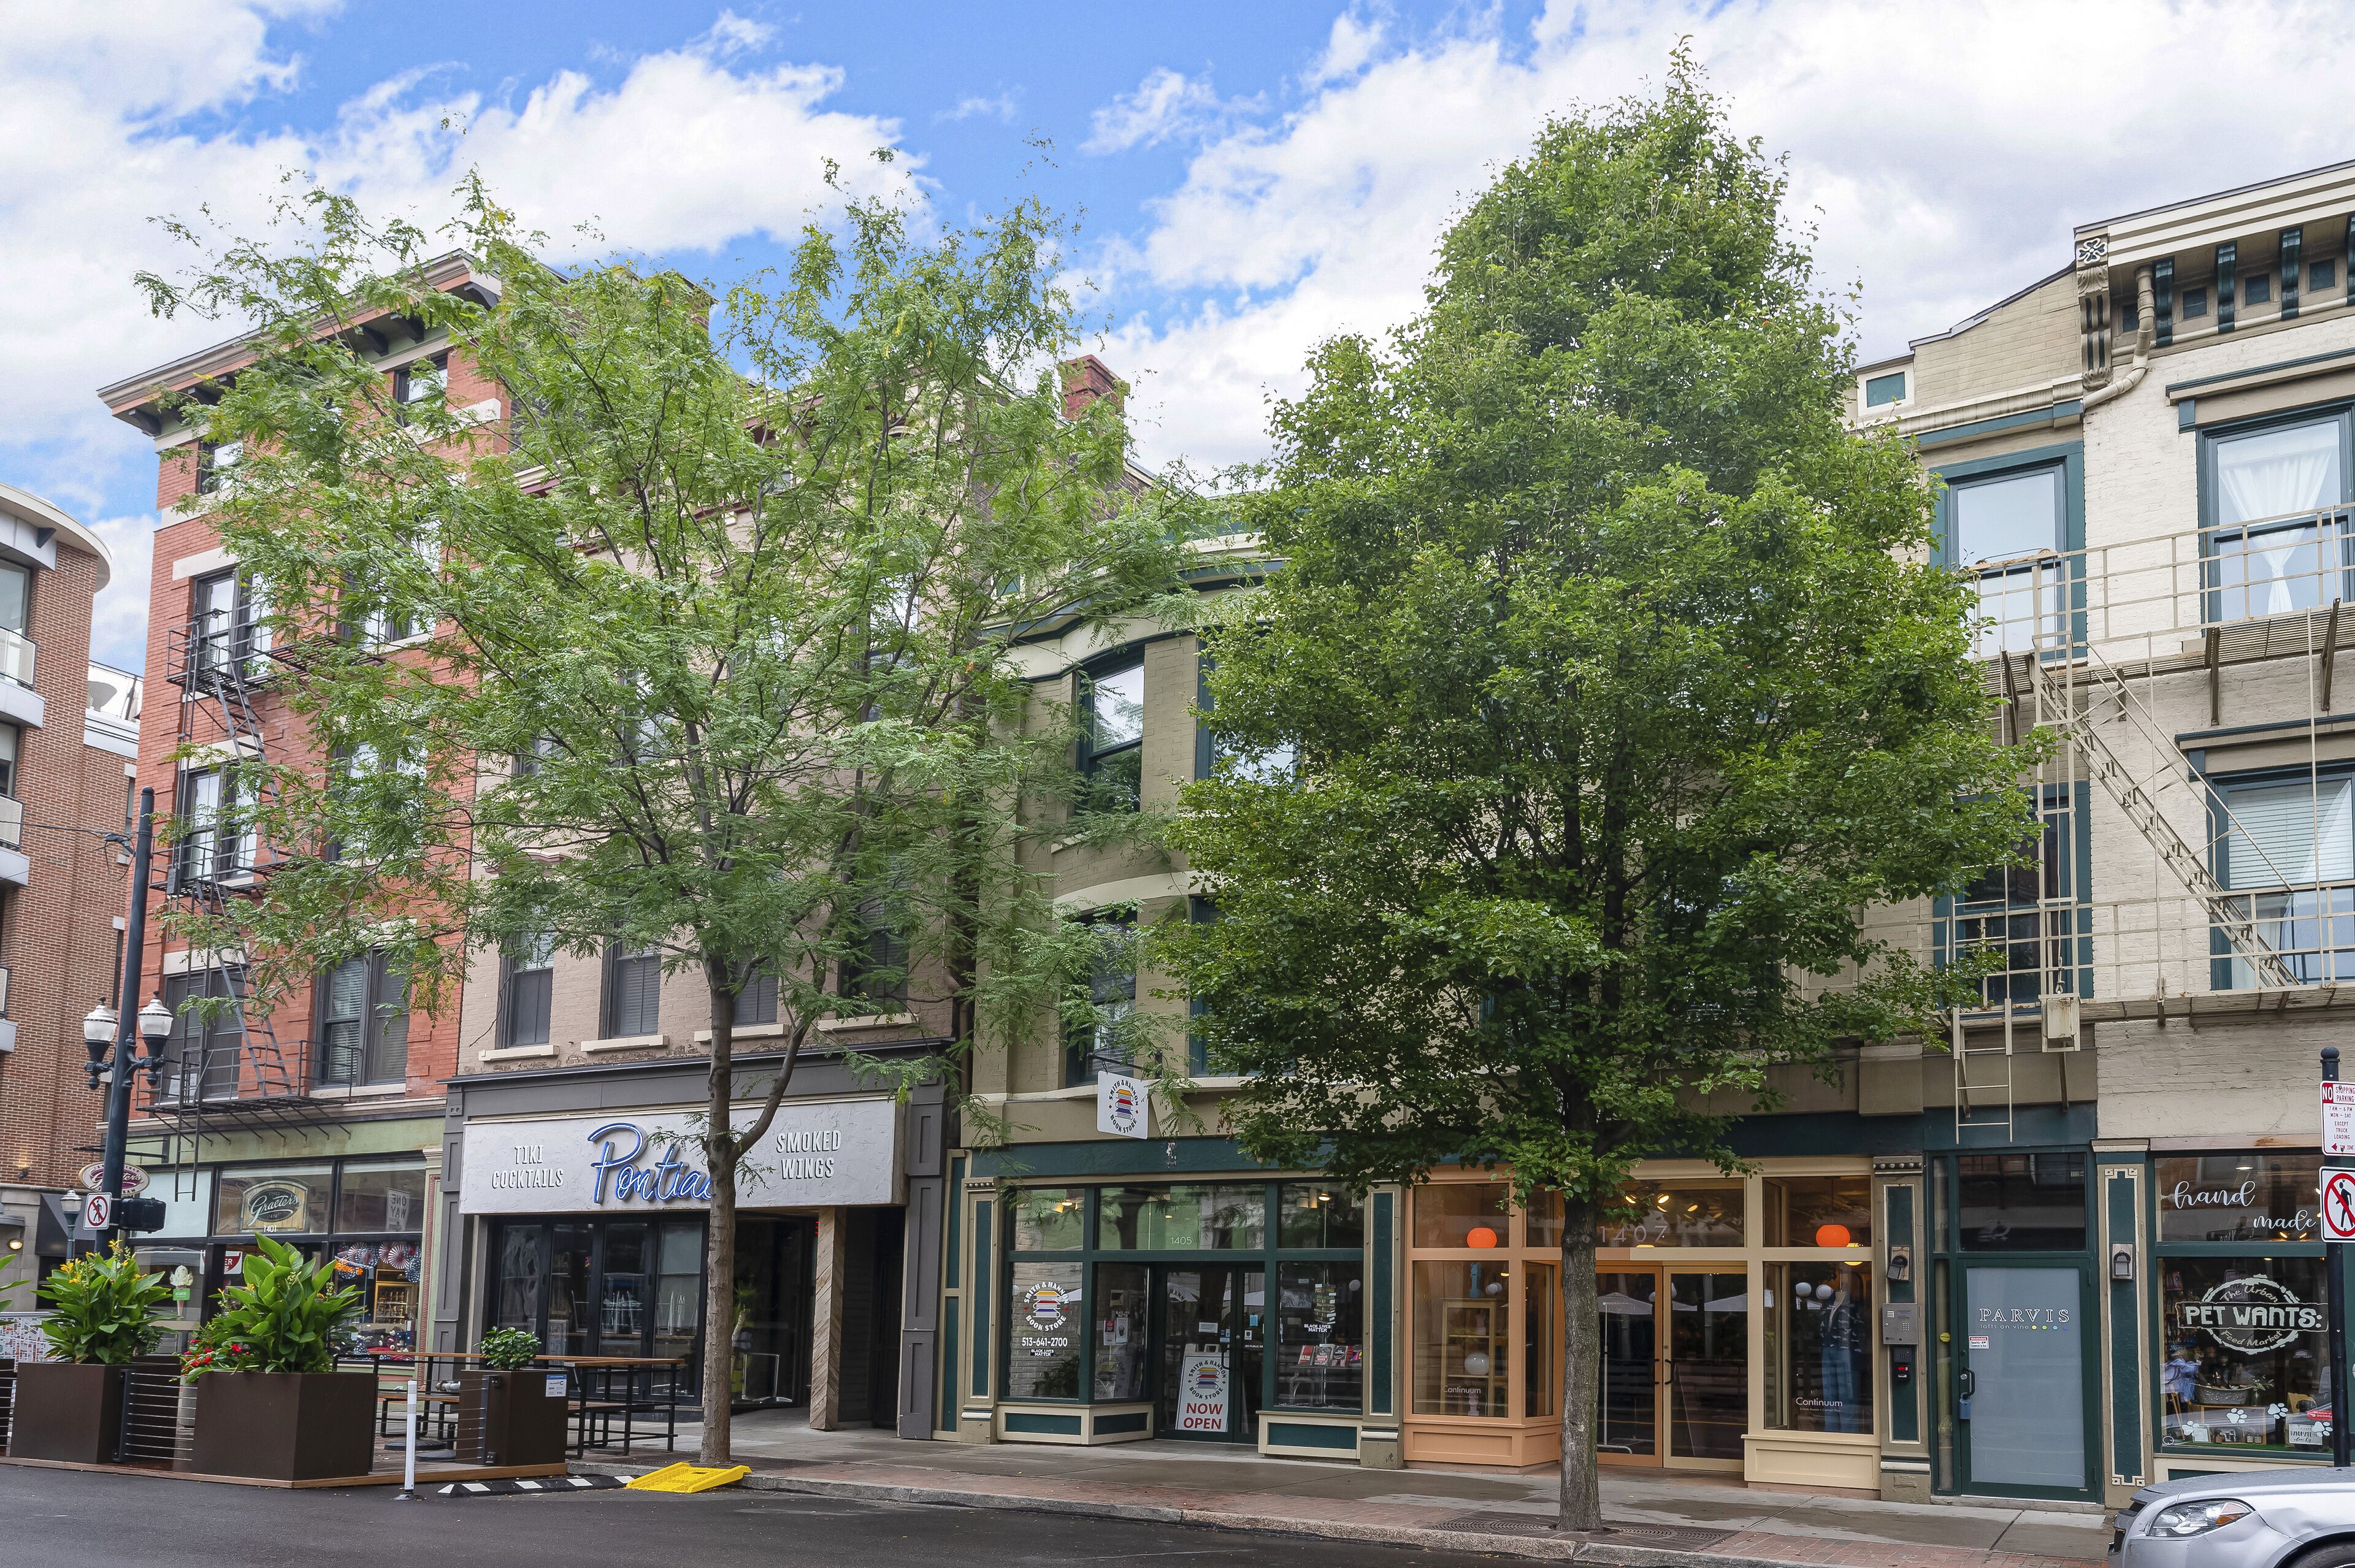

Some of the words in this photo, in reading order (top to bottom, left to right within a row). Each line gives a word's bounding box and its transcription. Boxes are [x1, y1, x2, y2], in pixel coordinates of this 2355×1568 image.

[1109, 1080, 1120, 1101] SMITH
[1125, 1080, 1139, 1106] HANNON
[2322, 1087, 2333, 1100] NO
[1110, 1114, 1122, 1132] BOOK
[1123, 1118, 1137, 1133] STORE
[776, 1130, 842, 1153] SMOKED
[515, 1144, 544, 1165] TIKI
[781, 1157, 835, 1180] WINGS
[492, 1168, 564, 1189] COCKTAILS
[2174, 1180, 2256, 1209] hand
[247, 1194, 301, 1226] Graeter's
[2253, 1209, 2317, 1231] made
[1170, 1236, 1193, 1245] 1405
[1599, 1225, 1668, 1243] 1407
[1024, 1282, 1041, 1304] SMITH
[1047, 1281, 1070, 1304] HANNON
[2219, 1290, 2242, 1302] The
[2243, 1285, 2278, 1303] Urban
[1025, 1314, 1044, 1331] BOOK
[1044, 1314, 1067, 1332] STORE
[1979, 1308, 2070, 1323] PARVIS
[2185, 1306, 2226, 1325] PET
[1021, 1337, 1068, 1347] 513-641-2700
[2220, 1329, 2245, 1345] Feed
[2246, 1330, 2283, 1347] Market
[1189, 1361, 1203, 1378] SMITH
[1209, 1360, 1227, 1379] HANNON
[1189, 1386, 1203, 1399] BOOK
[1204, 1386, 1224, 1400] STORE
[1442, 1385, 1481, 1393] Continuum
[1186, 1402, 1223, 1415] NOW
[1796, 1397, 1843, 1407] Continuum
[1183, 1417, 1222, 1430] OPEN
